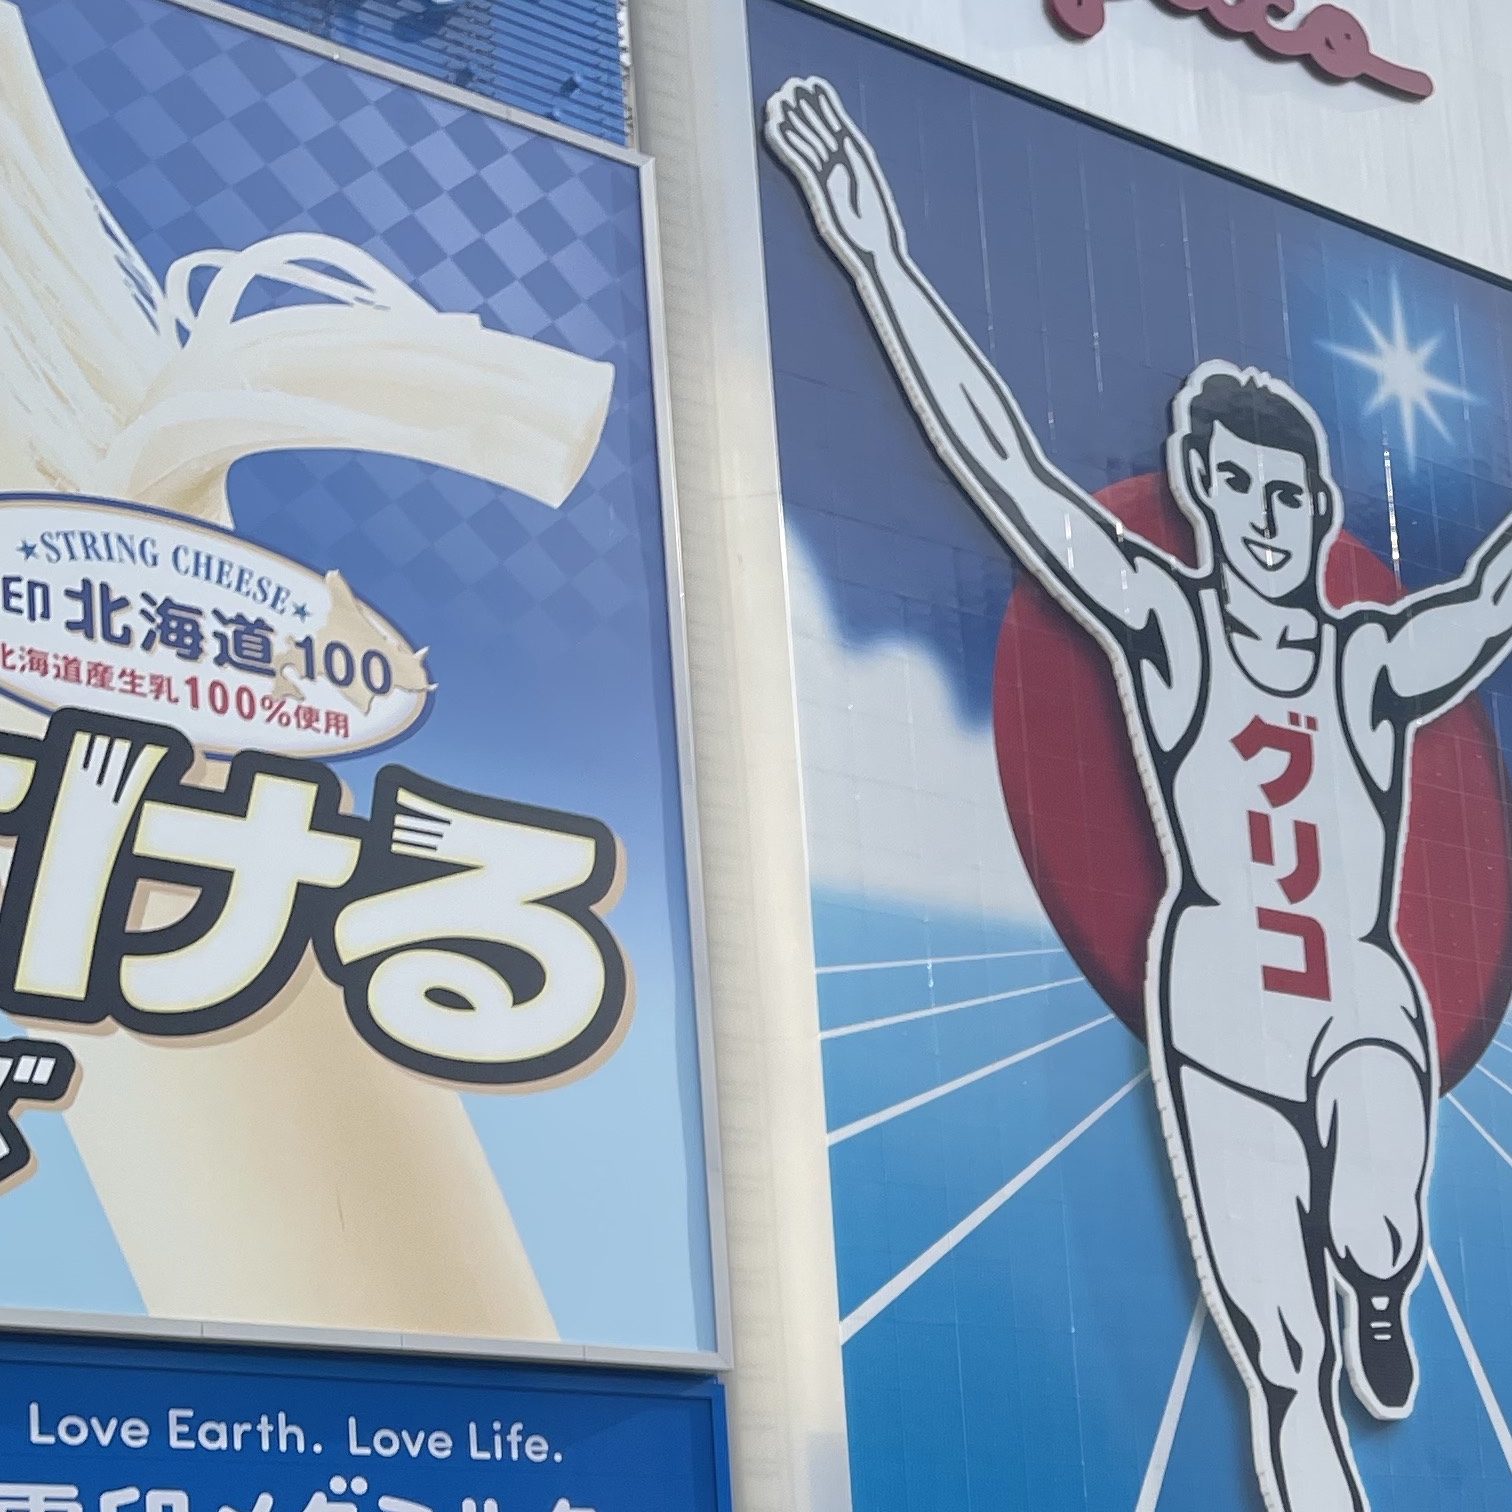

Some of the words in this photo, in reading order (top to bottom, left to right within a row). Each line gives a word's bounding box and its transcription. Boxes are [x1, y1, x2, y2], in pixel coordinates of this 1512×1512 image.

[39, 529, 159, 568] STRING
[171, 544, 291, 617] CHEESE
[0, 722, 612, 1066] ける
[1229, 710, 1333, 1003] グリコ
[29, 1401, 149, 1447] Love
[168, 1408, 323, 1455] Earth.
[348, 1416, 453, 1459] Love
[469, 1420, 563, 1463] Life.
